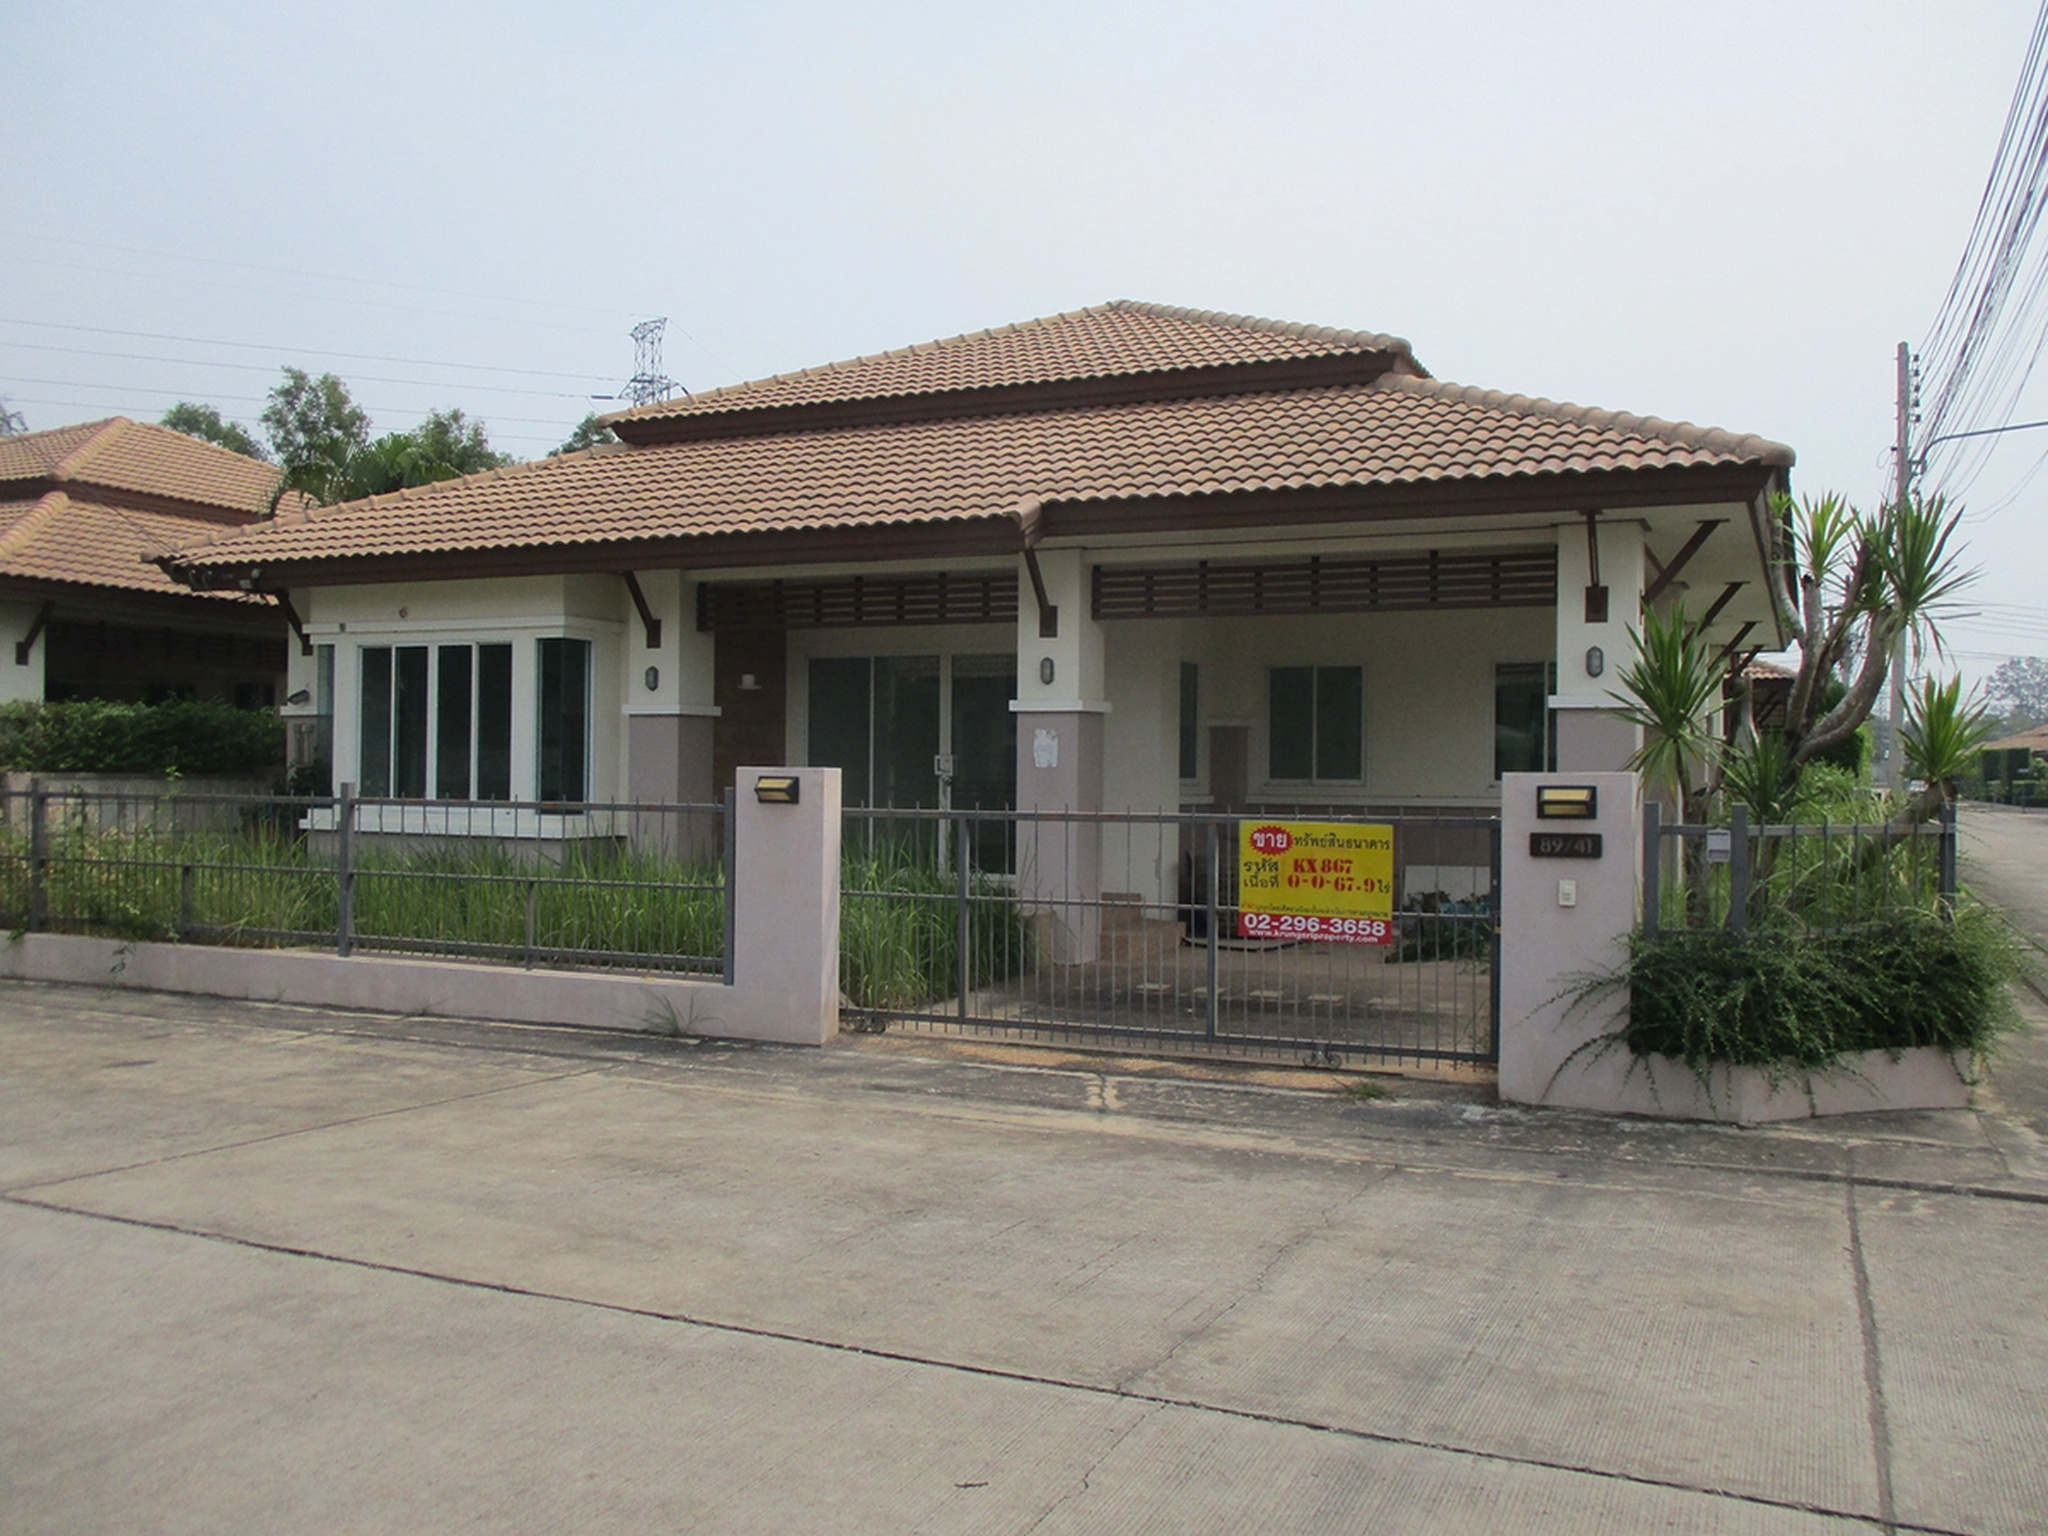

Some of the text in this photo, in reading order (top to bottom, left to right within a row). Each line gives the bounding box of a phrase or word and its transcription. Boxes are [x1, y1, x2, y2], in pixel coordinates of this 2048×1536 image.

[1253, 832, 1390, 850] ขาย ทรัพย์สินธนาคาร
[1540, 837, 1593, 854] 89/41
[1244, 857, 1353, 874] รหัส KX 867
[1244, 914, 1386, 936] 02-296-3658
[1249, 929, 1378, 943] www.krungsriproperty.com
